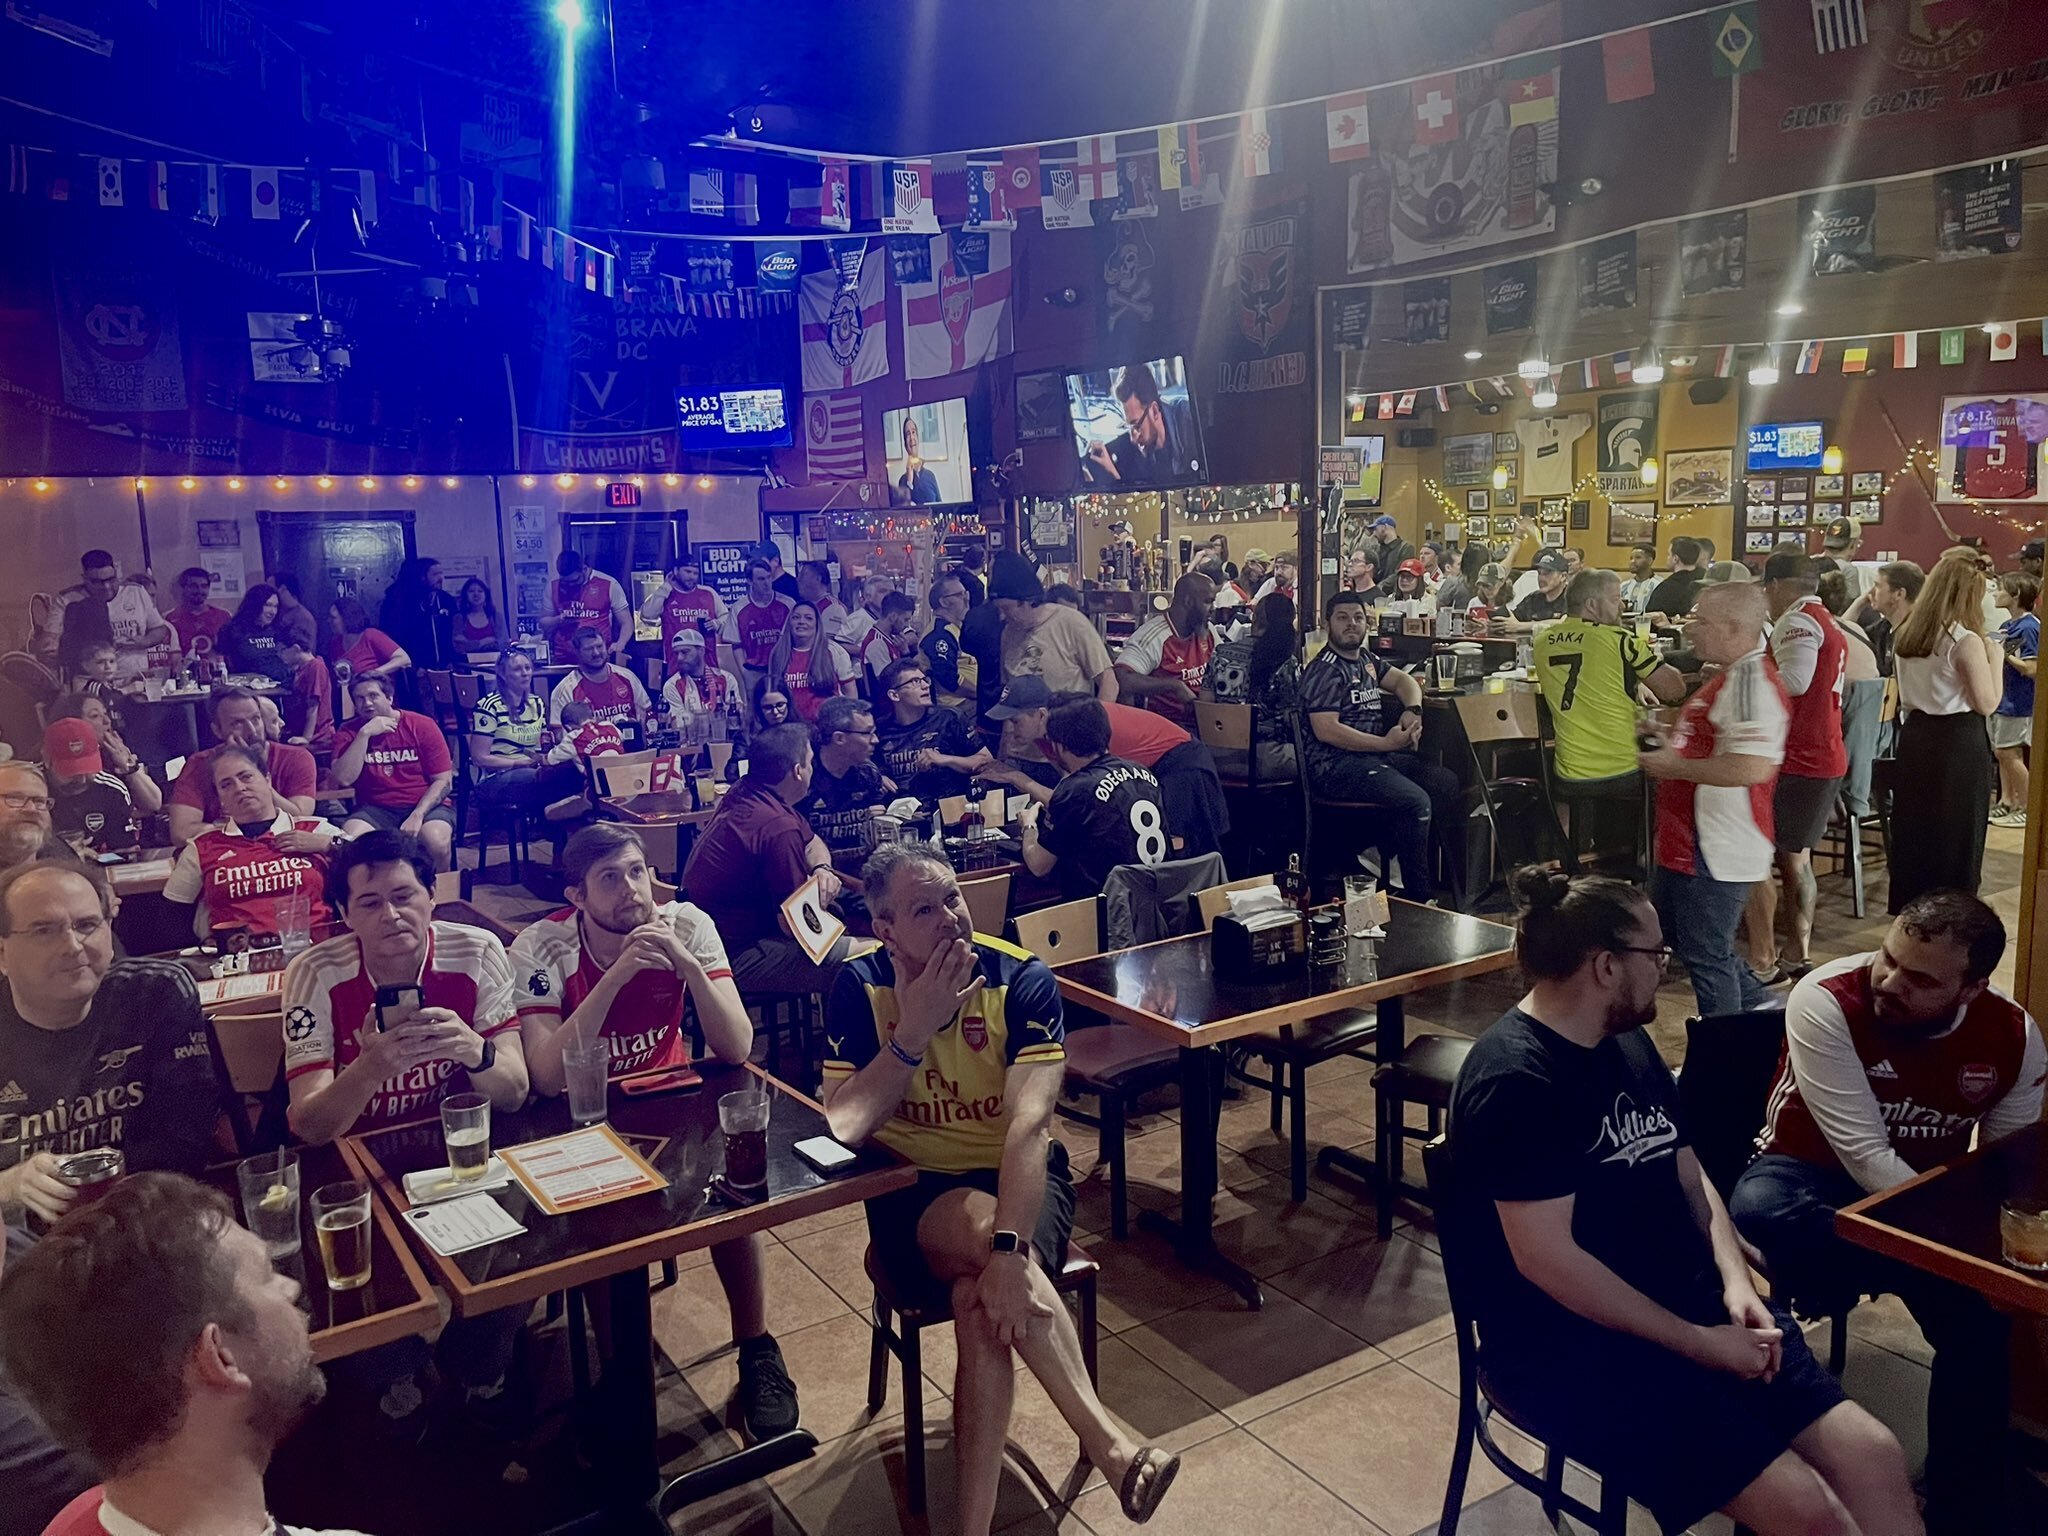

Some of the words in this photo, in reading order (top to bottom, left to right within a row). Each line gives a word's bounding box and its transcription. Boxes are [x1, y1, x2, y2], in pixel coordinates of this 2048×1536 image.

[895, 171, 918, 188] USA
[1052, 171, 1073, 187] USA
[1823, 225, 1865, 238] IGHT
[767, 263, 798, 271] LIGHT
[771, 256, 795, 265] BUD
[1498, 282, 1524, 293] BUD
[1491, 290, 1528, 304] LIGHT
[615, 316, 698, 340] BRAVA
[617, 341, 649, 361] DC
[678, 396, 720, 413] $1.83
[1749, 431, 1777, 444] $1.83
[543, 436, 666, 468] CHAMPIONS
[1986, 430, 2008, 466] 5
[1599, 476, 1654, 491] SPARTAN
[611, 484, 637, 505] EXIT
[516, 539, 543, 549] $4.50
[709, 548, 741, 561] BUD
[703, 560, 748, 574] LIGHT
[672, 607, 709, 617] Emirates
[1547, 631, 1585, 645] SAKA
[1180, 661, 1208, 681] Emira
[1548, 652, 1583, 712] 7
[592, 702, 632, 719] mirates
[1094, 766, 1159, 803] ØDEGAARD
[809, 808, 866, 827] Emirate
[1130, 799, 1167, 868] 8
[213, 856, 313, 886] Emirates
[229, 880, 252, 899] FLY
[255, 870, 303, 894] BETTER
[924, 1068, 959, 1098] Fly
[386, 1081, 449, 1118] BETTER
[896, 1092, 1004, 1125] mirate
